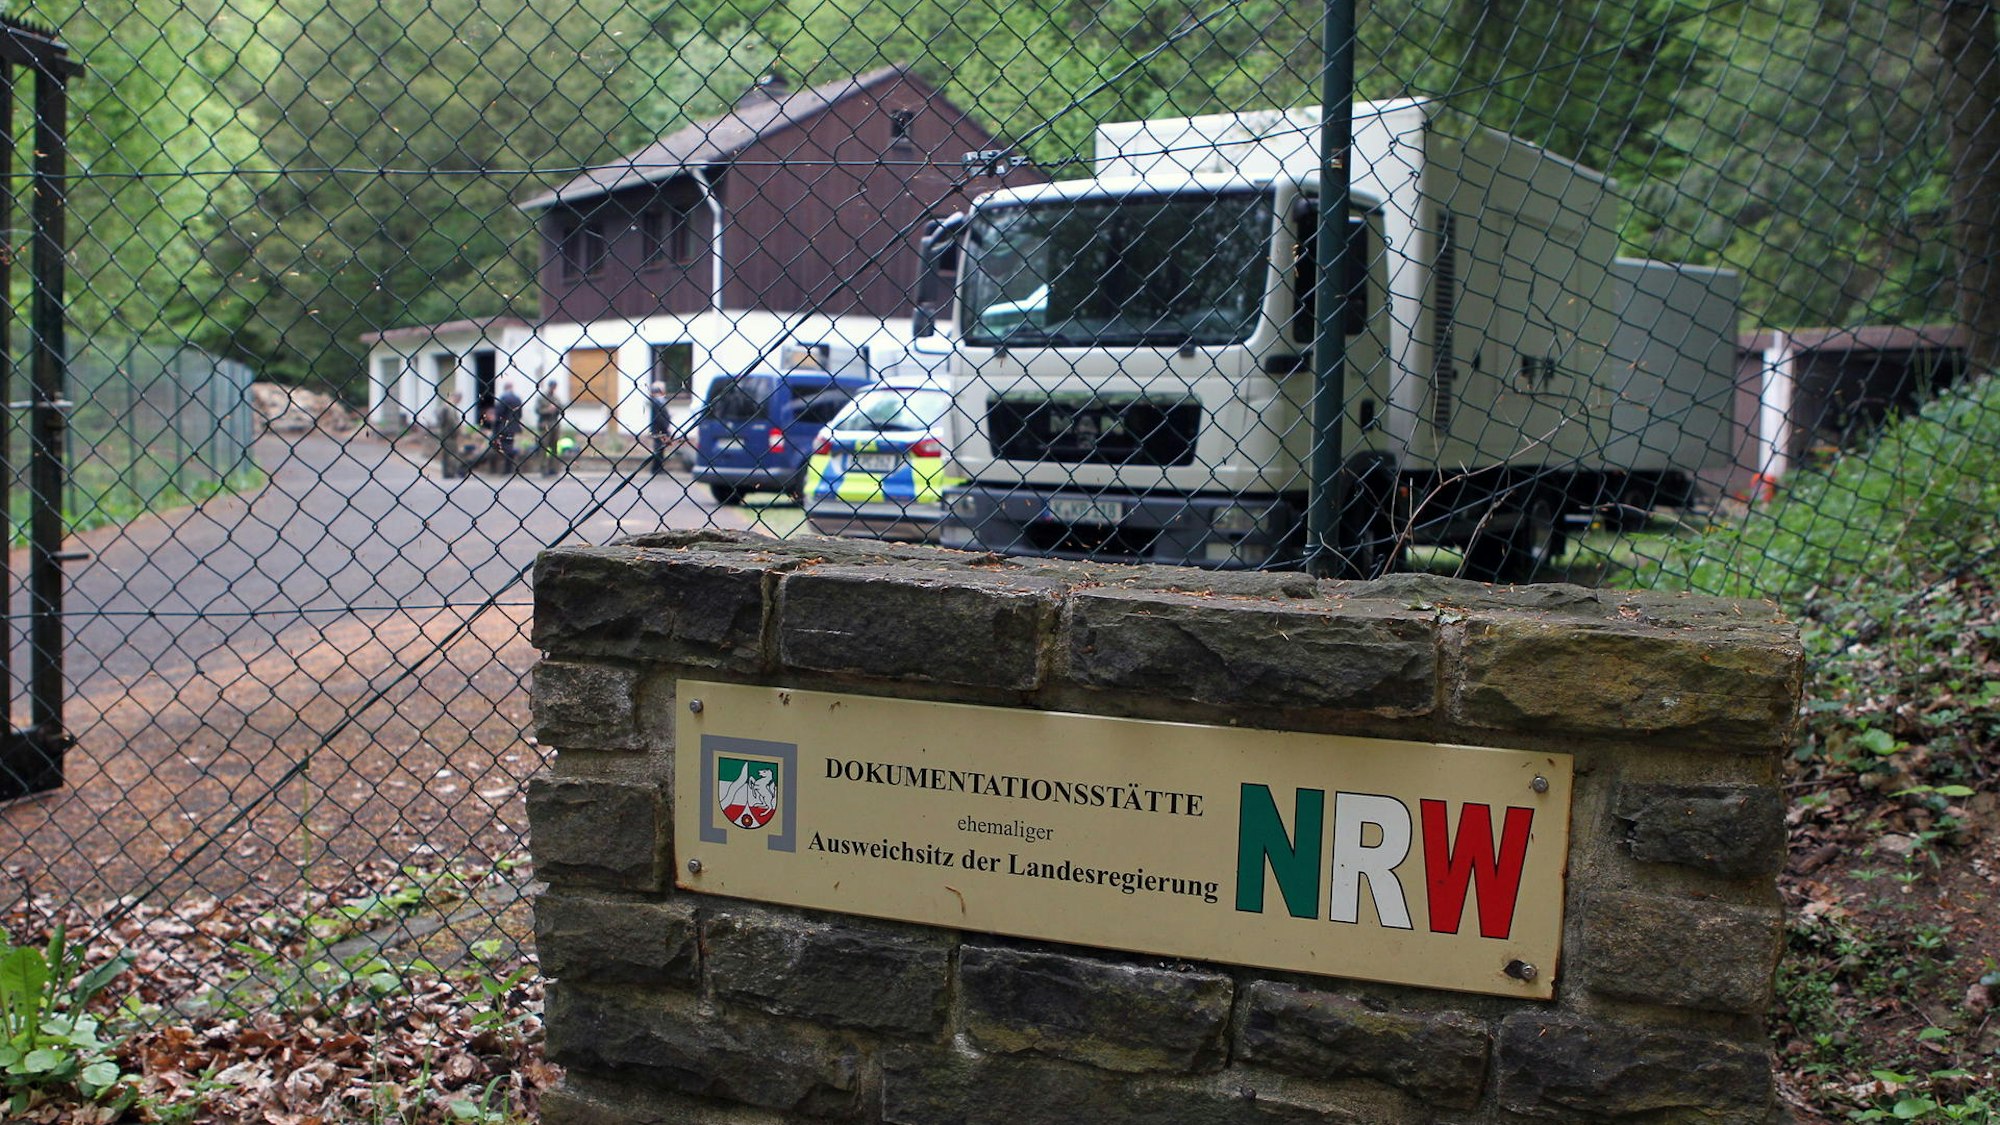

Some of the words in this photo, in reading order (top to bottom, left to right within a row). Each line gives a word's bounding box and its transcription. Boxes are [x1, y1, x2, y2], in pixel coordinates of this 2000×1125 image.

[825, 757, 1203, 817] DOKUMENTATIONSSTÄTTE
[957, 815, 1054, 842] ehemaliger
[1235, 782, 1535, 940] NRW
[808, 831, 954, 868] Ausweichsitz
[961, 850, 1001, 873] der
[1009, 854, 1219, 903] Landesregierung
